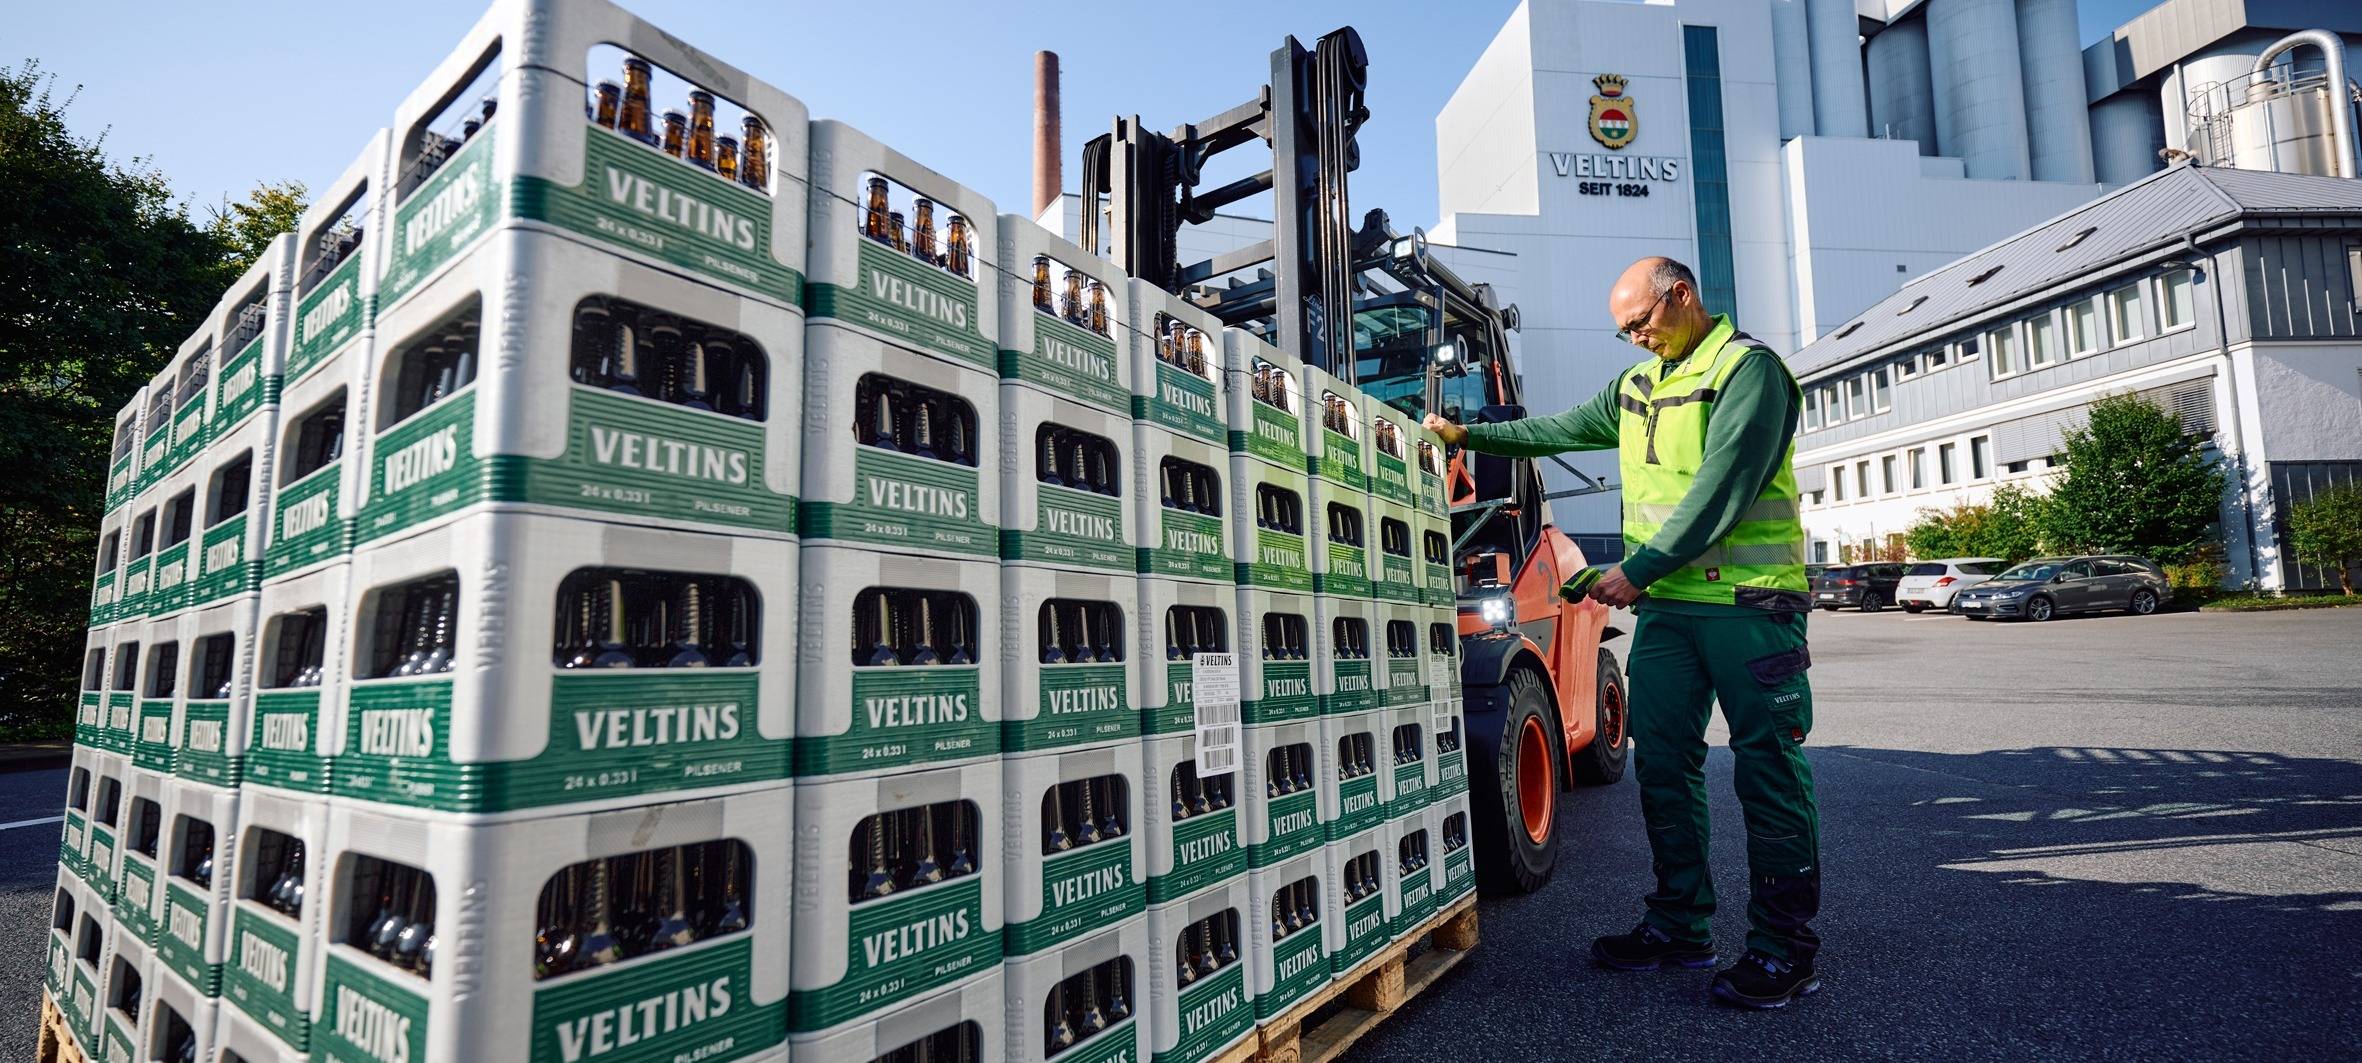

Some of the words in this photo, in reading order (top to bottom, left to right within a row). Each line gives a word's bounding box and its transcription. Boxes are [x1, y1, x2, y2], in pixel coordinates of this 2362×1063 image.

[1550, 152, 1680, 181] VELTINS
[1579, 182, 1612, 196] SEIT
[1616, 184, 1649, 197] 1824
[407, 164, 479, 254] VELTINS
[606, 166, 755, 251] VELTINS
[598, 217, 614, 230] 24
[618, 226, 626, 234] x
[705, 255, 759, 282] PILSENER
[872, 271, 966, 327] VELTINS
[868, 311, 878, 321] 24
[880, 316, 886, 324] x
[935, 335, 970, 352] PILSENER
[1044, 338, 1109, 380] VELTINS
[807, 358, 828, 436] VELTINS
[1163, 382, 1211, 417] VELTINS
[1002, 409, 1018, 476] VELTINS
[1258, 419, 1295, 448] VELTINS
[384, 424, 457, 495] VELTINS
[592, 426, 746, 484] VELTINS
[581, 484, 599, 496] 24
[602, 490, 610, 498] x
[869, 477, 967, 518] VELTINS
[694, 500, 750, 516] PILSENER
[864, 523, 879, 532] 24
[935, 531, 970, 544] PILSENER
[1048, 508, 1113, 540] VELTINS
[1168, 530, 1218, 554] VELTINS
[1263, 546, 1300, 568] VELTINS
[1333, 558, 1362, 577] VELTINS
[802, 581, 824, 663] VELTINS
[1002, 595, 1020, 663] VELTINS
[1206, 655, 1232, 666] VELTINS
[1268, 679, 1306, 697] VELTINS
[1339, 675, 1368, 691] VELTINS
[865, 693, 967, 729] VELTINS
[1048, 686, 1118, 714] VELTINS
[1773, 692, 1800, 704] VELTINS
[360, 708, 434, 758] VELTINS
[574, 703, 740, 752] VELTINS
[863, 747, 874, 759] 24
[876, 749, 882, 757] x
[934, 739, 971, 751] PILSENER
[565, 776, 583, 790] 24
[587, 777, 595, 787] x
[684, 761, 742, 777] PILSENER
[1344, 791, 1374, 814] VELTINS
[1003, 790, 1022, 863] VELTINS
[1274, 809, 1312, 836] VELTINS
[1180, 831, 1231, 865] VELTINS
[800, 823, 820, 911] VELTINS
[1052, 863, 1123, 908] VELTINS
[863, 908, 969, 968] VELTINS
[1349, 910, 1380, 940] VELTINS
[452, 879, 487, 1001] VELTINS
[935, 955, 971, 976] PILSENER
[1279, 944, 1318, 980] VELTINS
[860, 990, 871, 1003] 24
[873, 989, 879, 998] x
[1186, 986, 1238, 1035] VELTINS
[557, 977, 731, 1062] VELTINS
